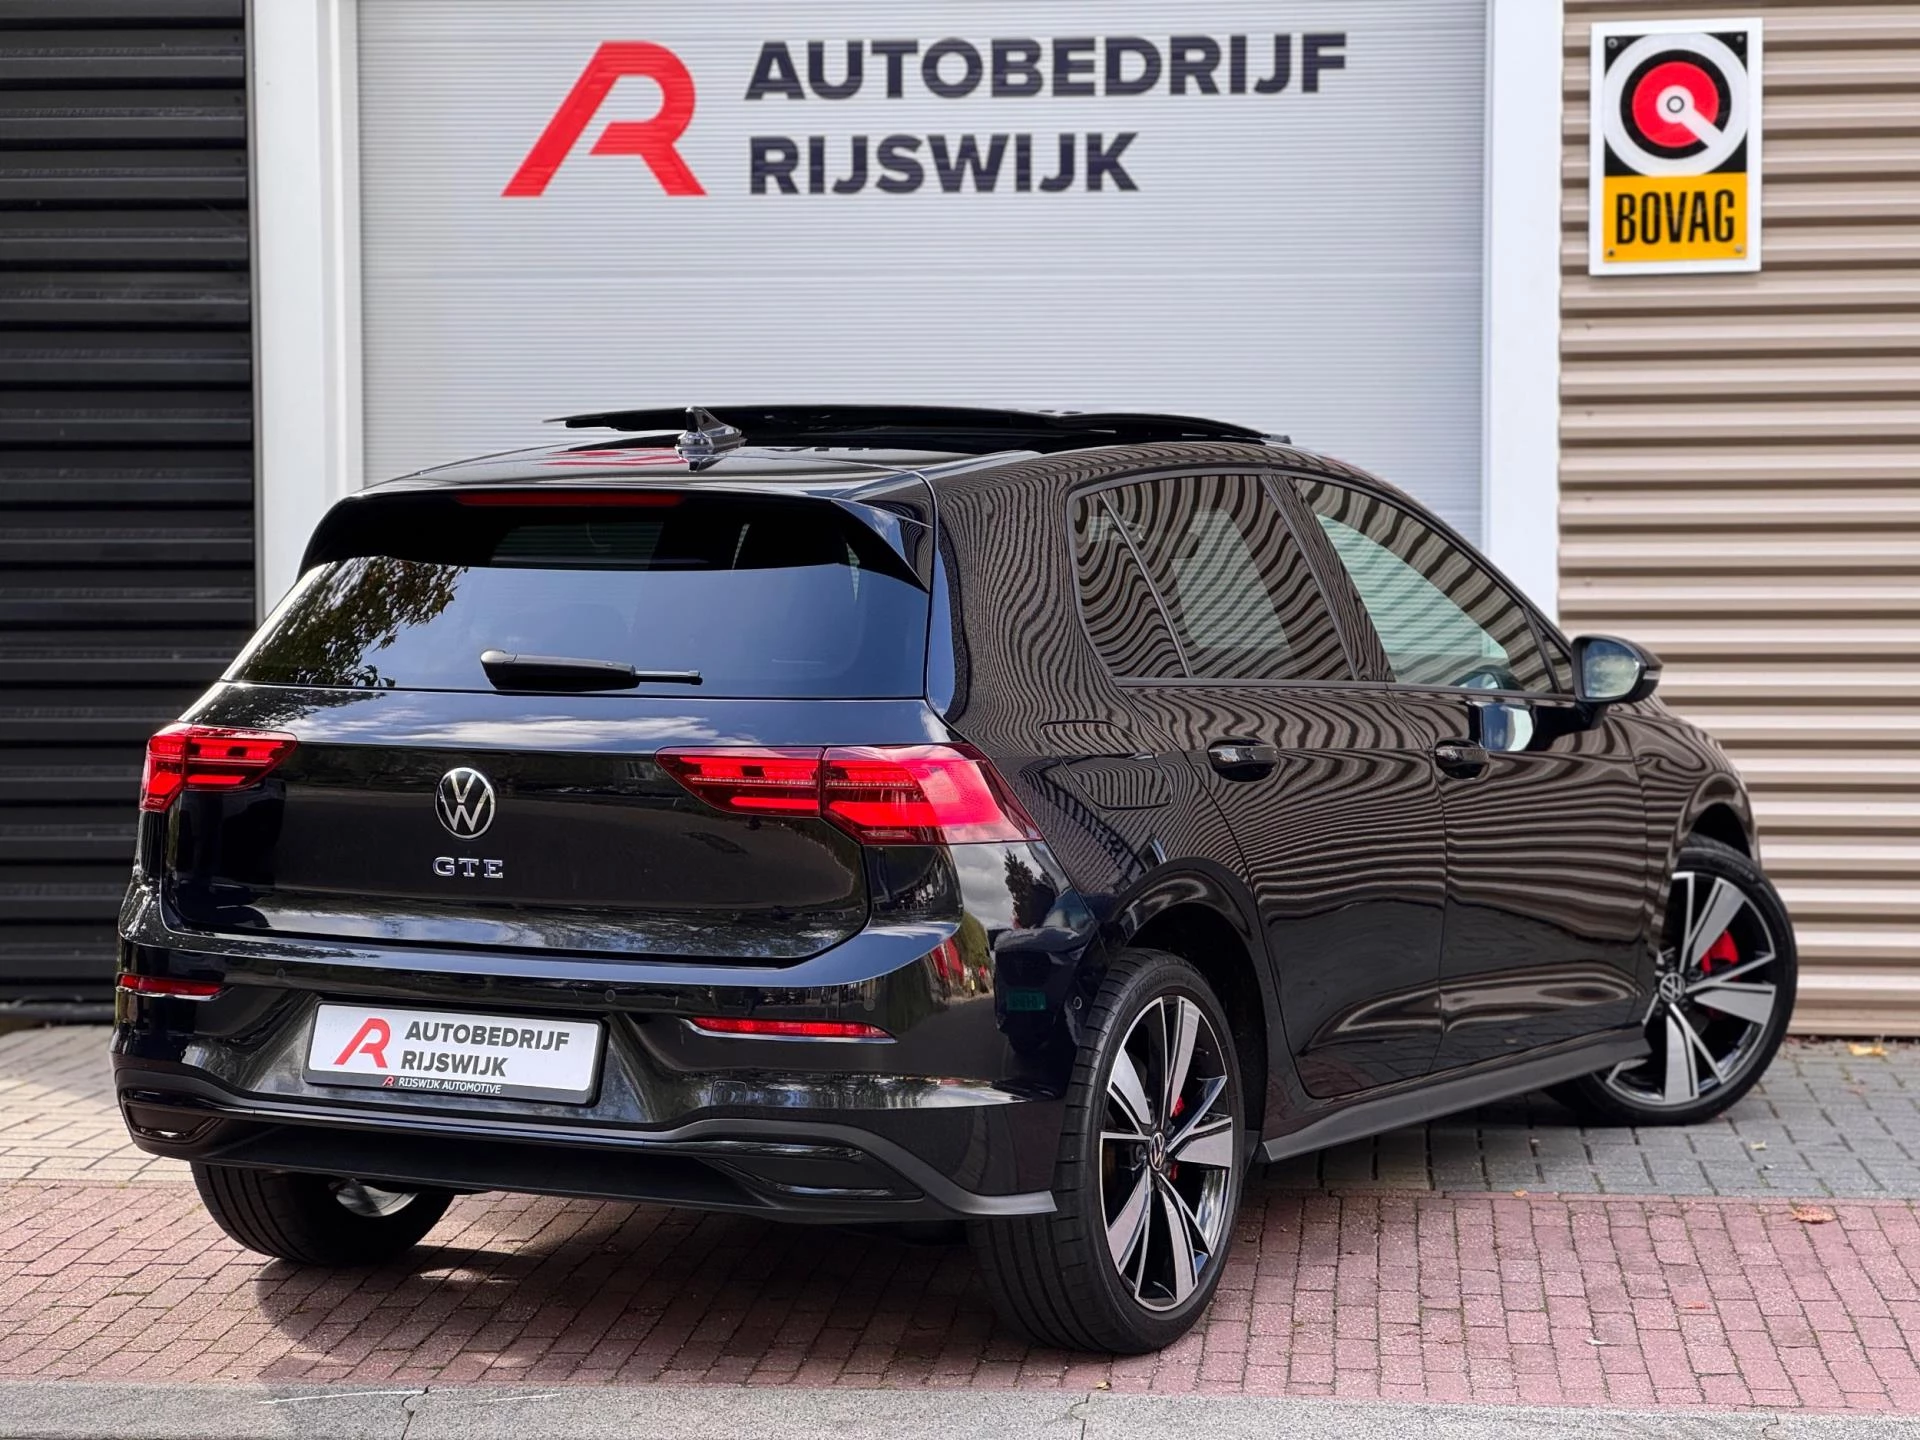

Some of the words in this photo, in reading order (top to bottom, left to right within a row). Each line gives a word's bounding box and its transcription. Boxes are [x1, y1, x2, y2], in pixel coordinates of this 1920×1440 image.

[744, 33, 1347, 101] AUTOBEDRIJF
[749, 132, 1139, 195] RIJSWIJK
[1616, 189, 1735, 245] BOVAG
[432, 856, 504, 878] GTE
[404, 1020, 570, 1051] AUTOBEDRIJF
[401, 1050, 509, 1077] RIJSWIJK
[398, 1077, 440, 1089] RIJSWIJK
[441, 1079, 502, 1094] AUTOMOTIVE
